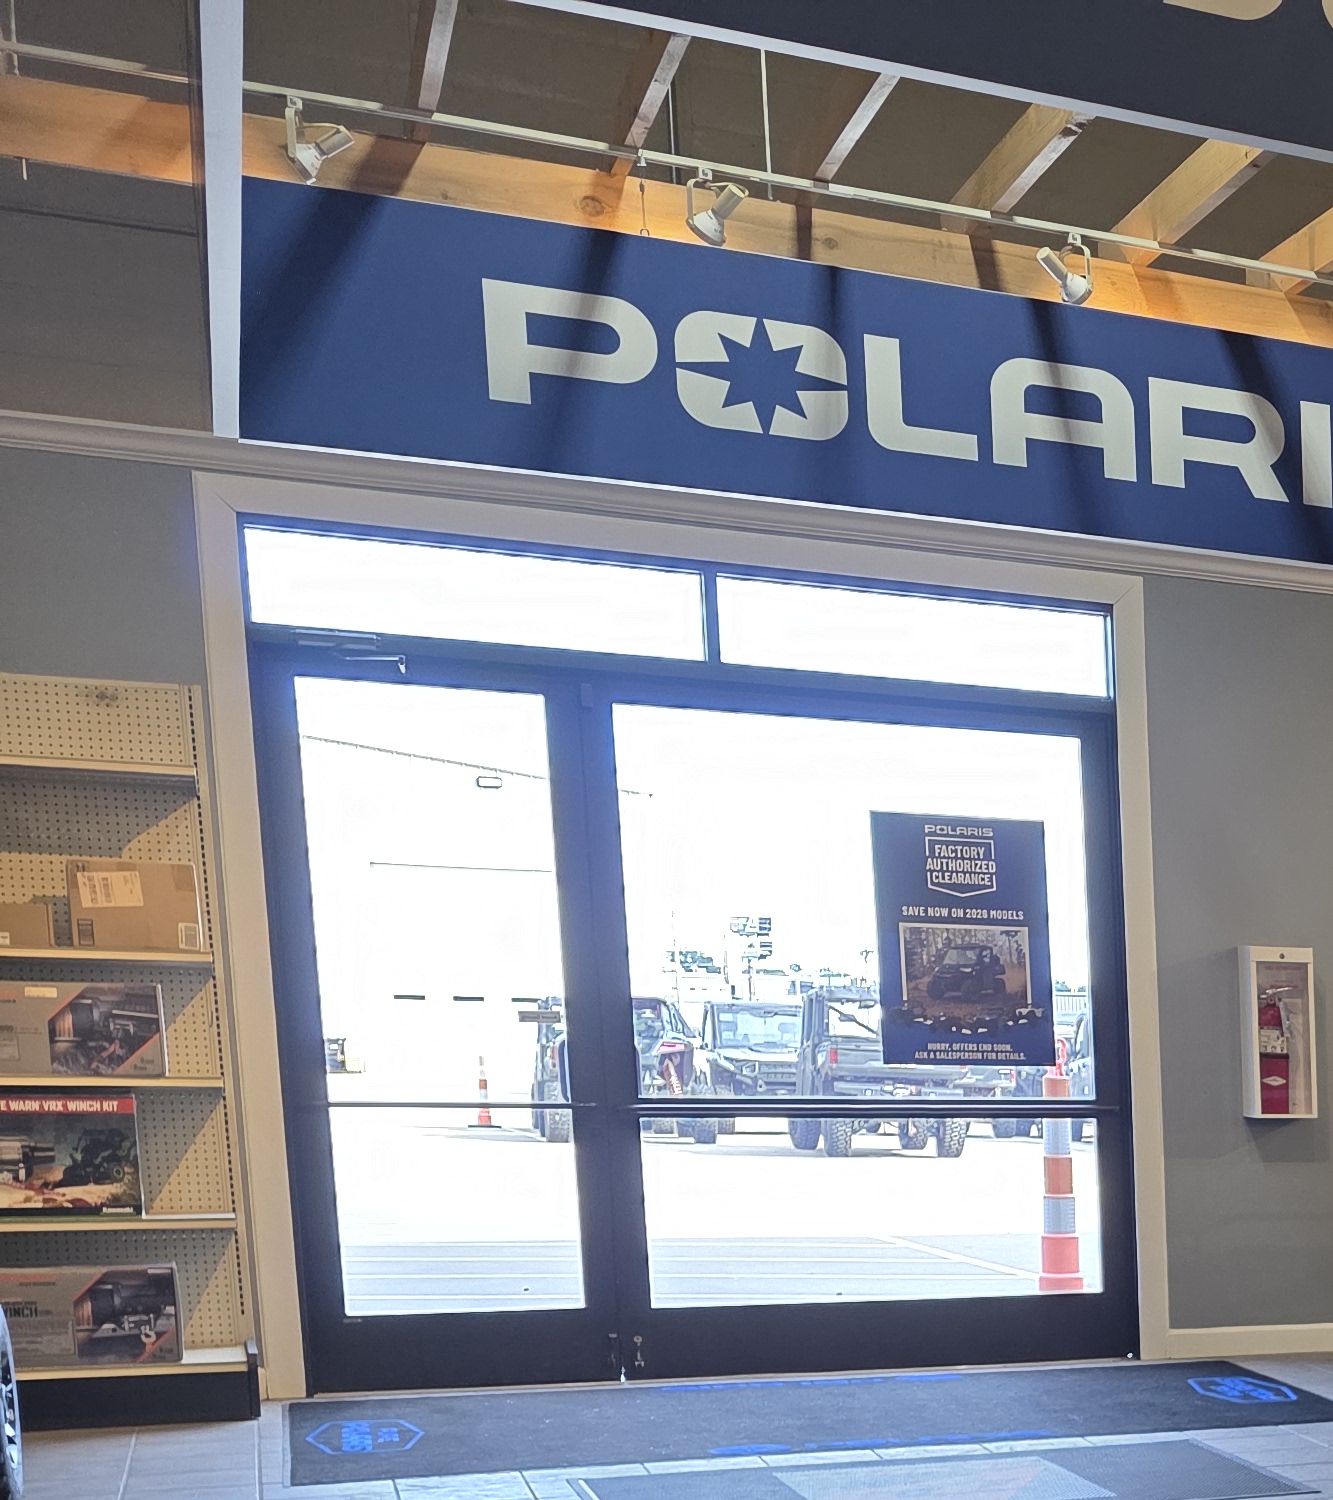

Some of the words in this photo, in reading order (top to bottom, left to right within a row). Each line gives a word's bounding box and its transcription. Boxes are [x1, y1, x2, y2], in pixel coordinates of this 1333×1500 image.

[924, 824, 994, 837] POLARIS
[934, 844, 985, 859] FACTORY
[926, 858, 996, 873] AUTHORIZED
[932, 872, 991, 886] CLEARANCE
[902, 906, 926, 917] SAVE
[927, 907, 949, 918] NOW
[951, 908, 964, 918] ON
[989, 910, 1024, 920] MODELS
[936, 1051, 982, 1060] SALESPERSON
[9, 1100, 39, 1112] WARN
[67, 1101, 100, 1112] WINCH
[102, 1101, 118, 1112] KIT
